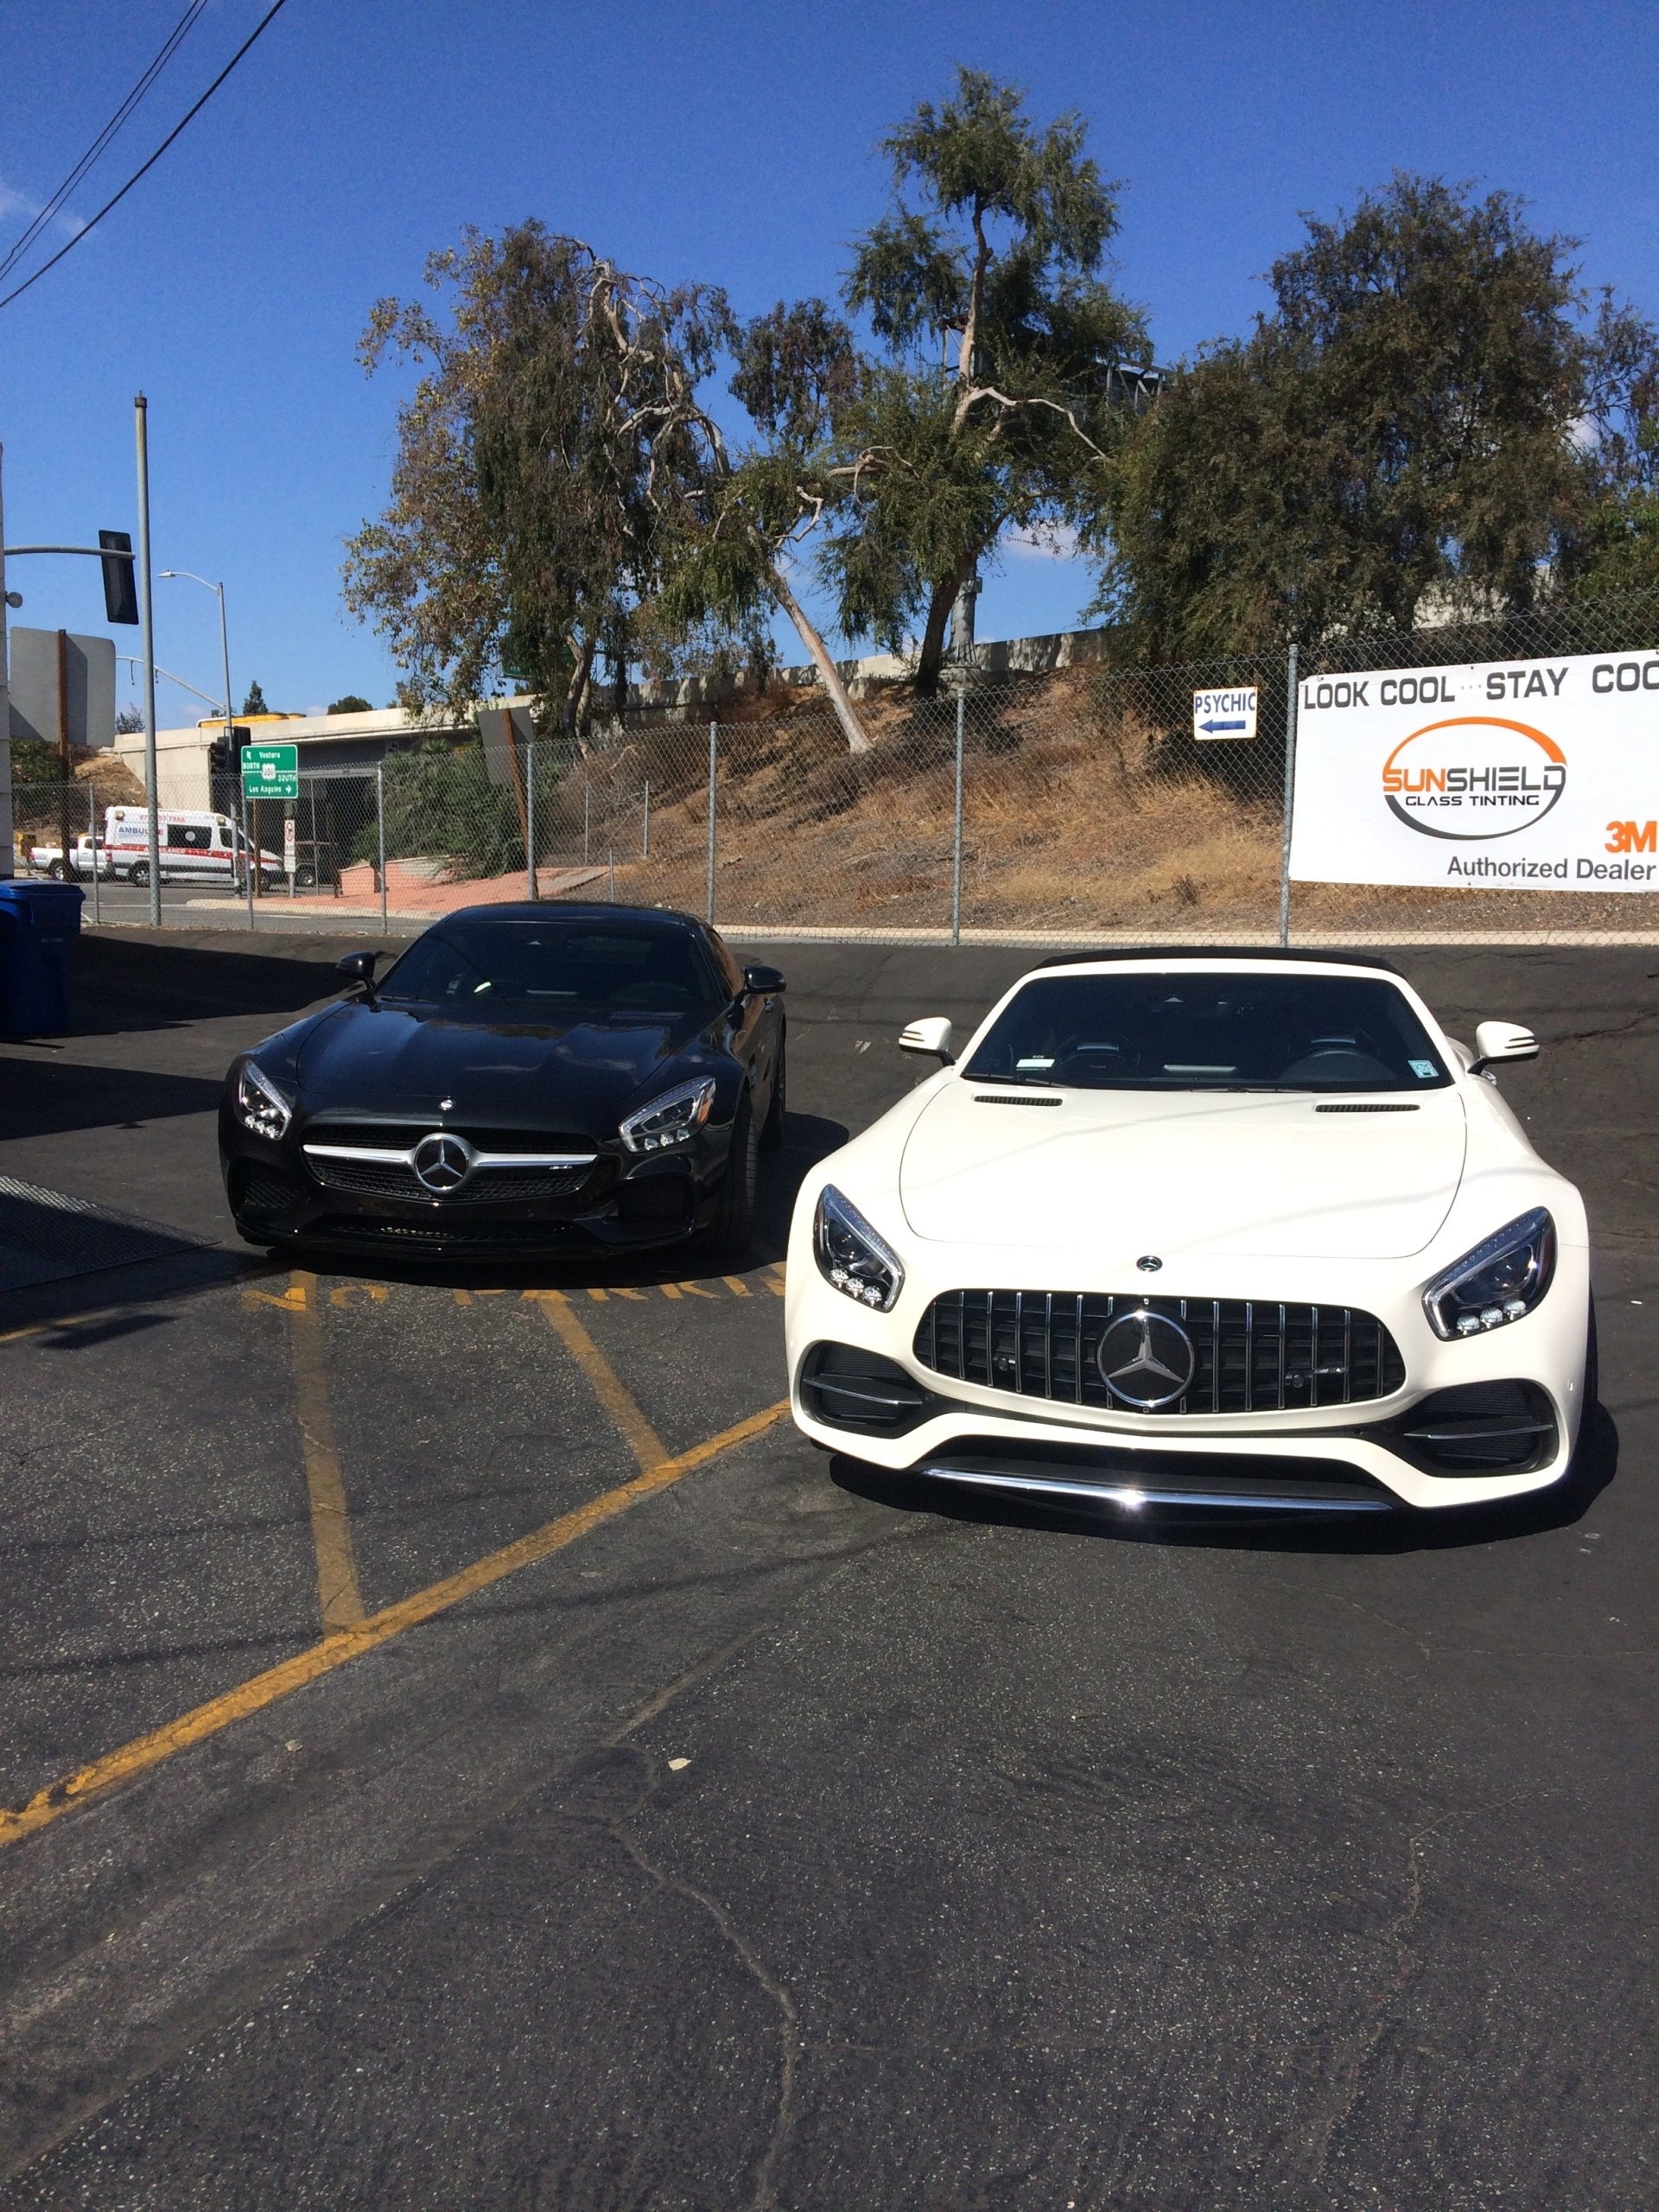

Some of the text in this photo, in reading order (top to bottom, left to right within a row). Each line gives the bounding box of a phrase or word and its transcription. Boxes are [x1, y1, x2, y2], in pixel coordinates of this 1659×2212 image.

[1304, 681, 1370, 709] LOOK
[1381, 676, 1455, 706] COOL
[1486, 667, 1569, 701] STAY
[1194, 692, 1256, 714] PSYCHIC
[242, 761, 261, 770] NORTH
[277, 773, 296, 783] SOUTH
[1382, 765, 1567, 792] SUNSHIELD
[249, 785, 282, 795] Los Angeles
[1405, 794, 1540, 806] GLASS TINTING
[1605, 820, 1657, 853] 3M
[1447, 856, 1656, 880] Authorized Dealer
